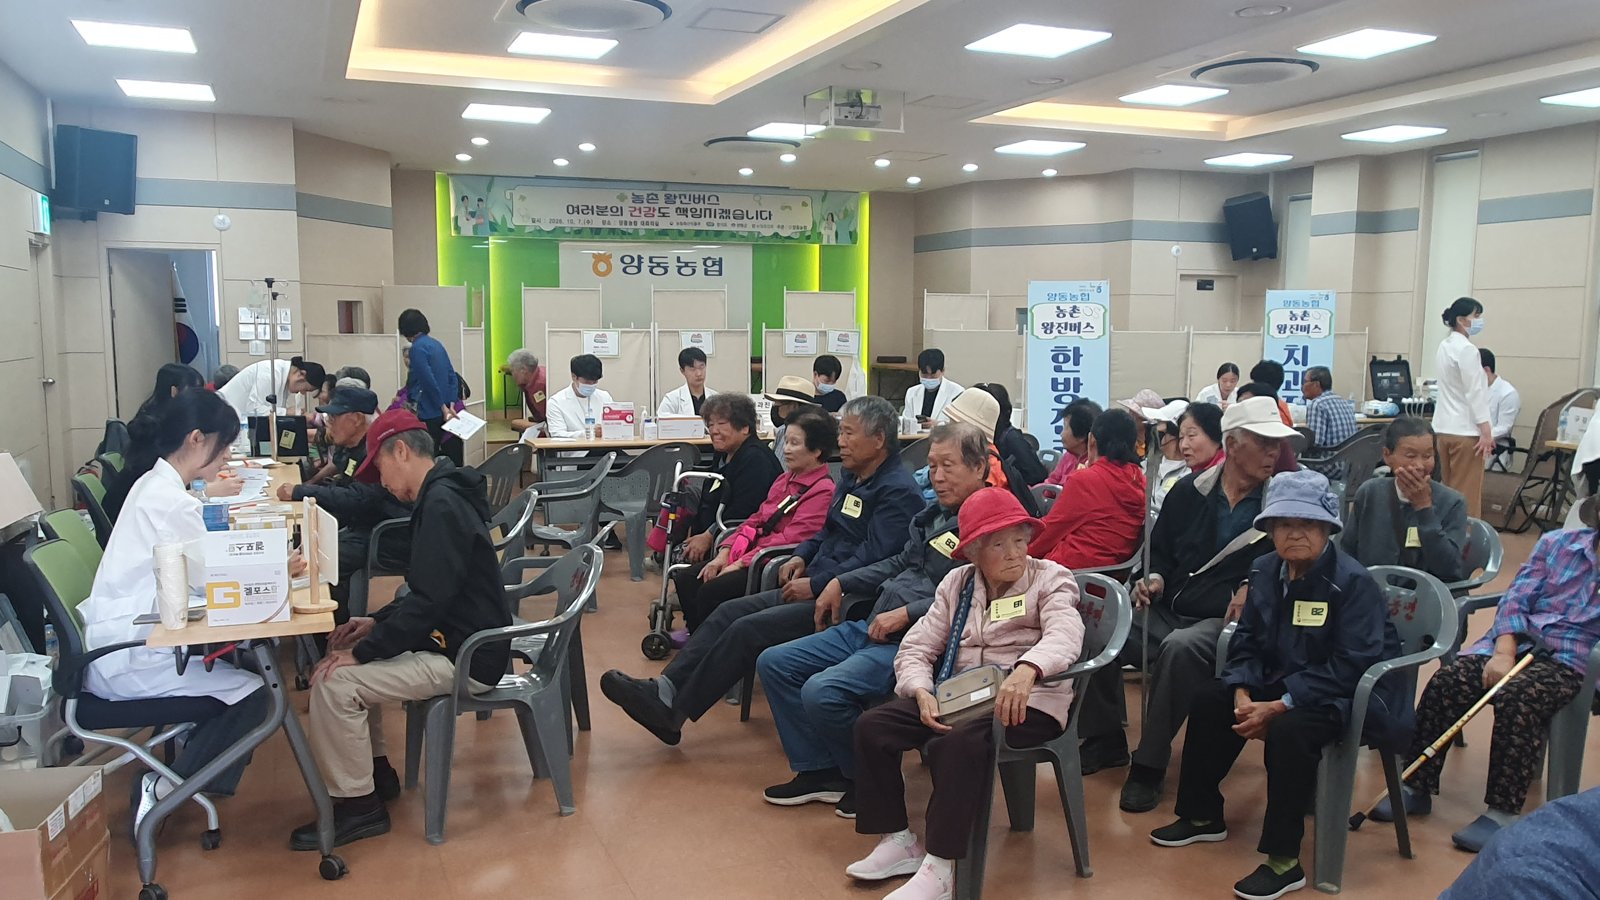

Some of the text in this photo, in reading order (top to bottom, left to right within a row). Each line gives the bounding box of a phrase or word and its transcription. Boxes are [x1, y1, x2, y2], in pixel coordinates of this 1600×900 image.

[631, 192, 720, 206] 농촌 왕진버스
[566, 204, 774, 221] 여러분의 건강도 책임지겠습니다
[620, 254, 723, 277] 양동농협
[1047, 292, 1090, 302] 양동농협
[1055, 304, 1081, 319] 농촌
[1289, 310, 1310, 321] 농촌
[1041, 321, 1095, 335] 왕진버스
[1276, 323, 1322, 335] 왕진버스
[1050, 346, 1083, 453] 한방
[945, 537, 956, 550] 83
[1013, 599, 1023, 608] 81
[1311, 607, 1324, 616] 82
